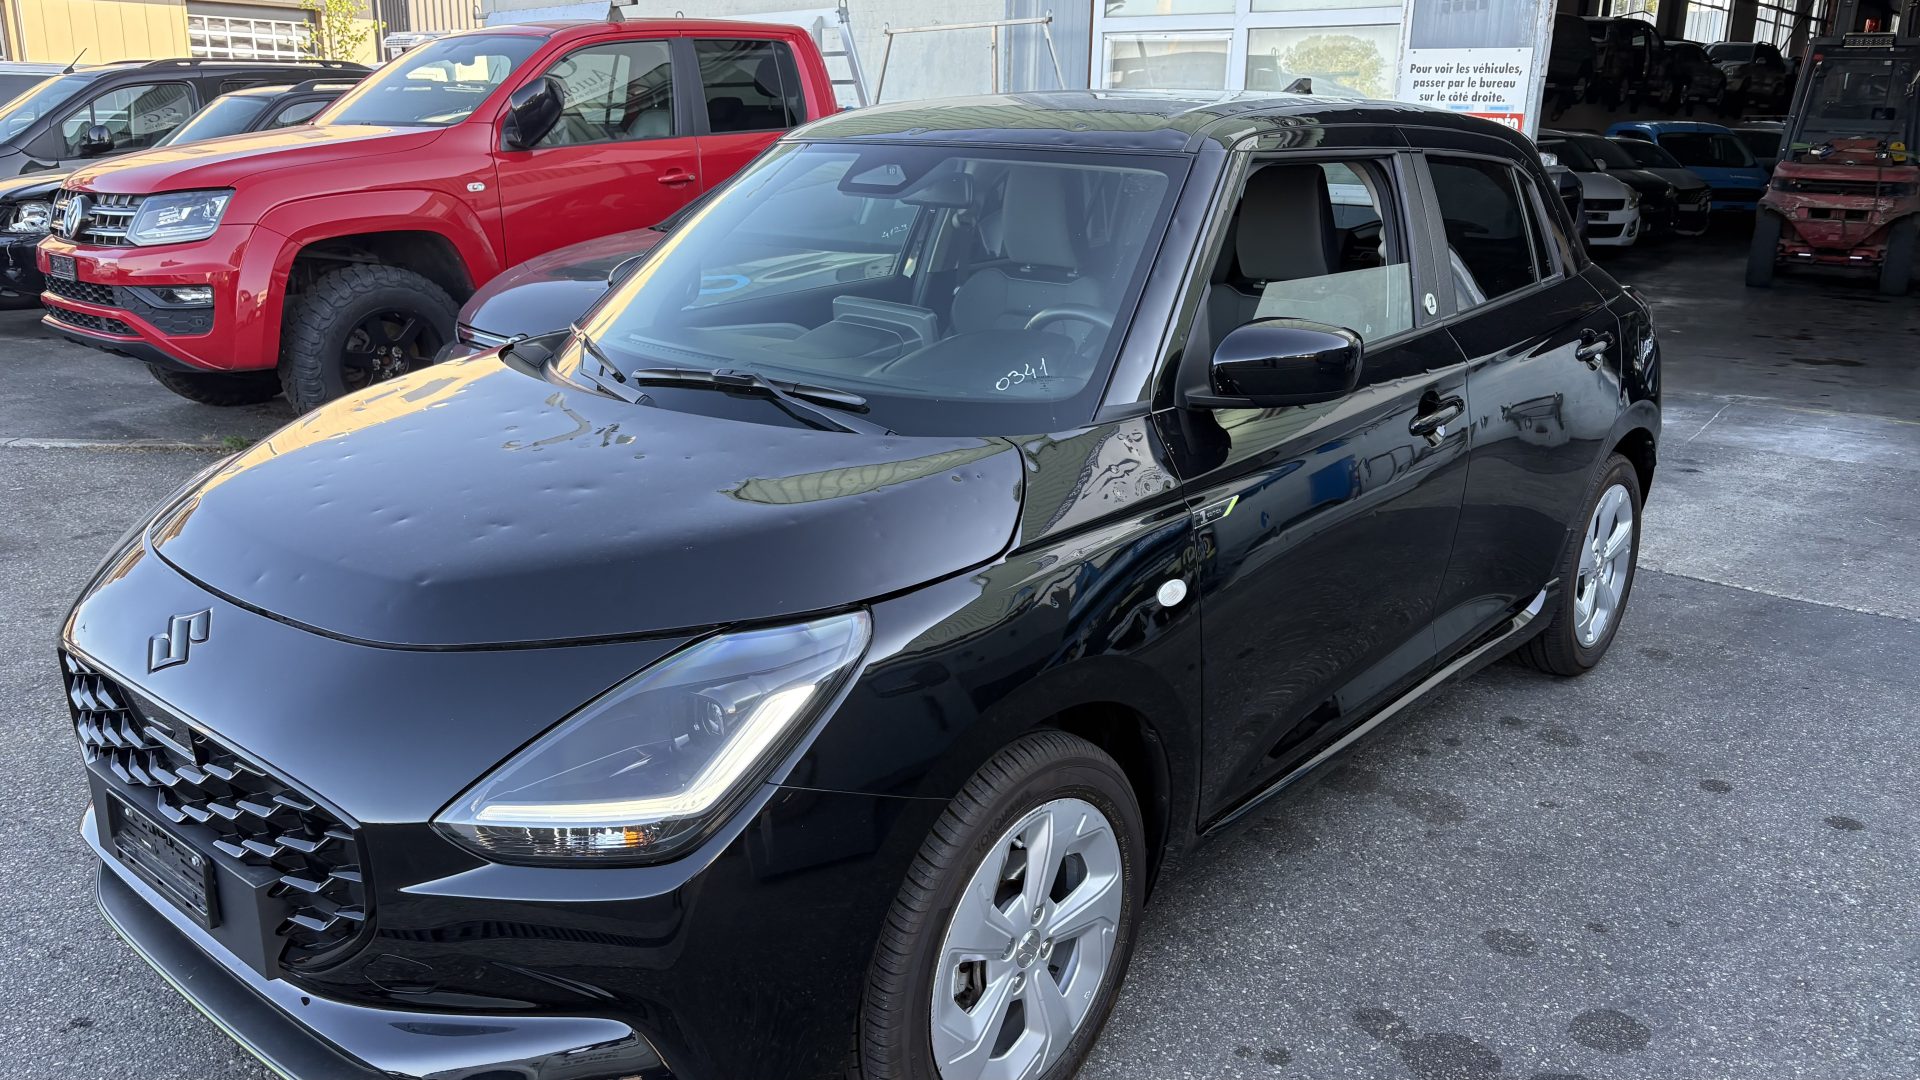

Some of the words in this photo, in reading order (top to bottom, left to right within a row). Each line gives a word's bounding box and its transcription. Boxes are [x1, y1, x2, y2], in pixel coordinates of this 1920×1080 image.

[1410, 63, 1432, 74] Pour
[1435, 62, 1454, 74] voir
[1456, 62, 1470, 74] les
[1473, 62, 1522, 76] véhicules,
[1413, 79, 1445, 90] passer
[1448, 79, 1465, 90] par
[1468, 76, 1477, 88] le
[1480, 77, 1516, 88] bureau
[1419, 92, 1434, 101] sur
[1437, 90, 1446, 102] le
[1449, 91, 1469, 102] côté
[1472, 91, 1506, 103] droite.
[996, 357, 1048, 391] 0341
